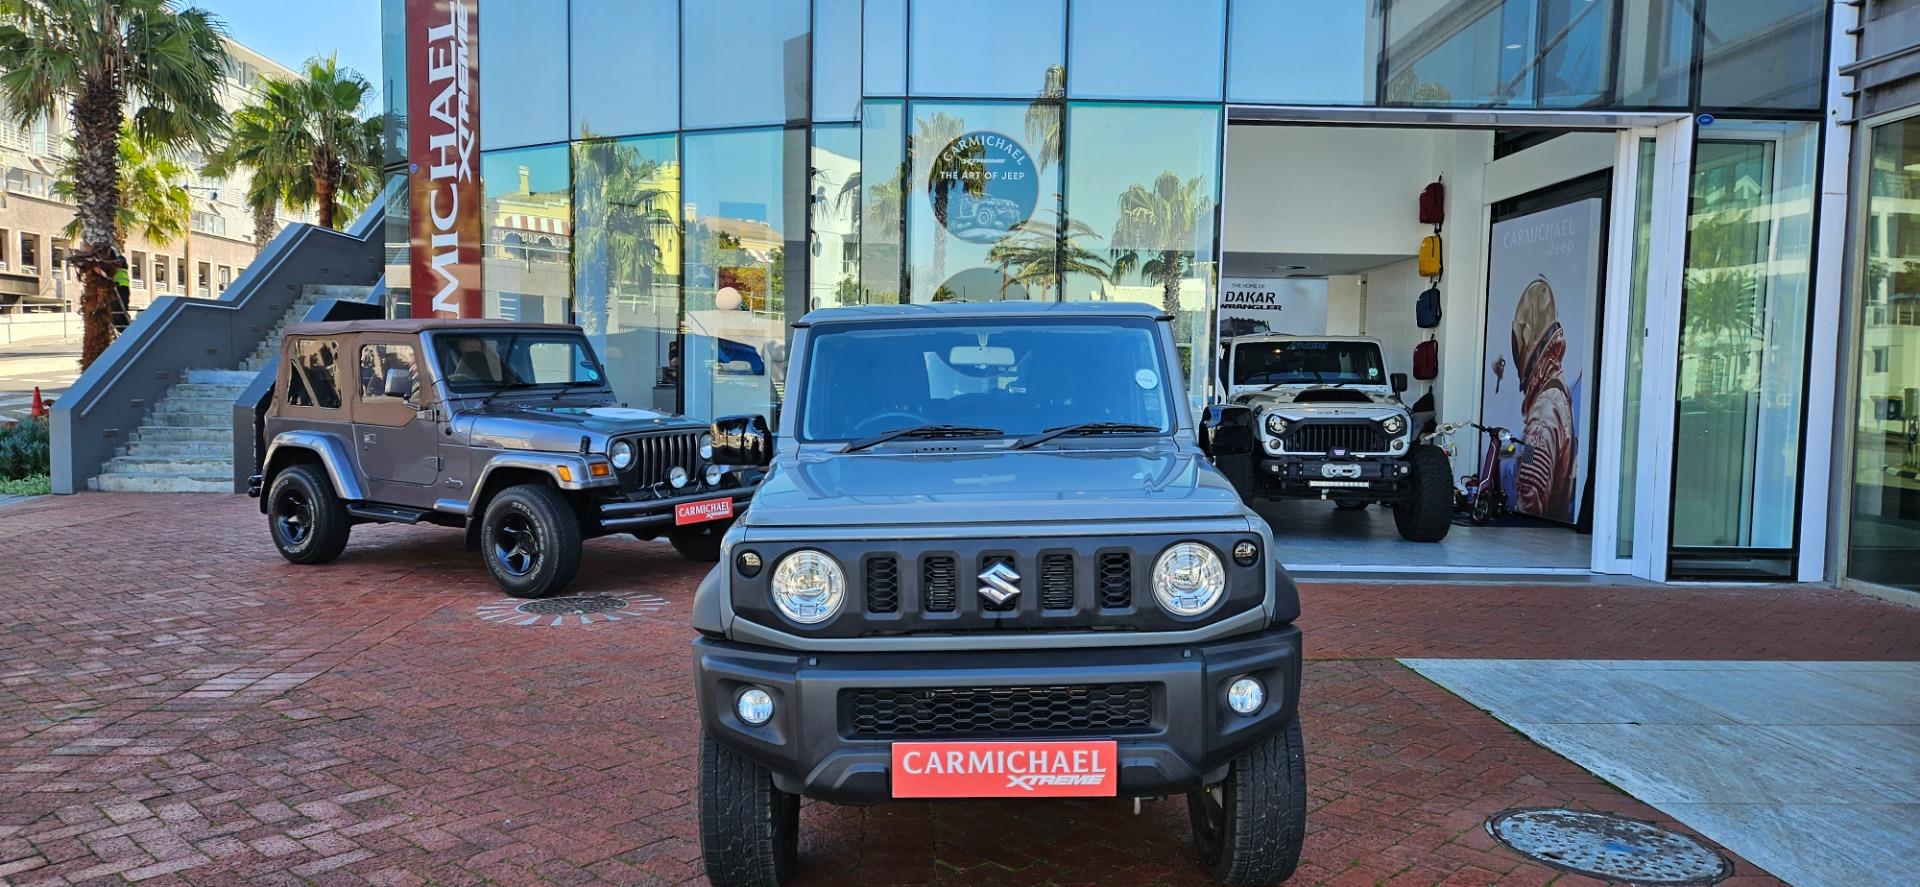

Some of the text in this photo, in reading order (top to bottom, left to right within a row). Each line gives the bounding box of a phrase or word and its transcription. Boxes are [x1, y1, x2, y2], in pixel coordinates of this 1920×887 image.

[943, 135, 1025, 165] CARMICHAEL
[428, 1, 460, 319] MICHAEL
[941, 171, 1025, 180] THE ART OF JEEP
[1503, 218, 1575, 249] CARMICHAEL
[1548, 240, 1576, 257] Jeep
[1225, 291, 1276, 304] DAKAR
[1220, 303, 1282, 311] WRANGLER
[679, 501, 732, 517] CARMICHAEL
[903, 750, 1107, 774] CARMICHAEL
[1005, 774, 1106, 791] XTREME
